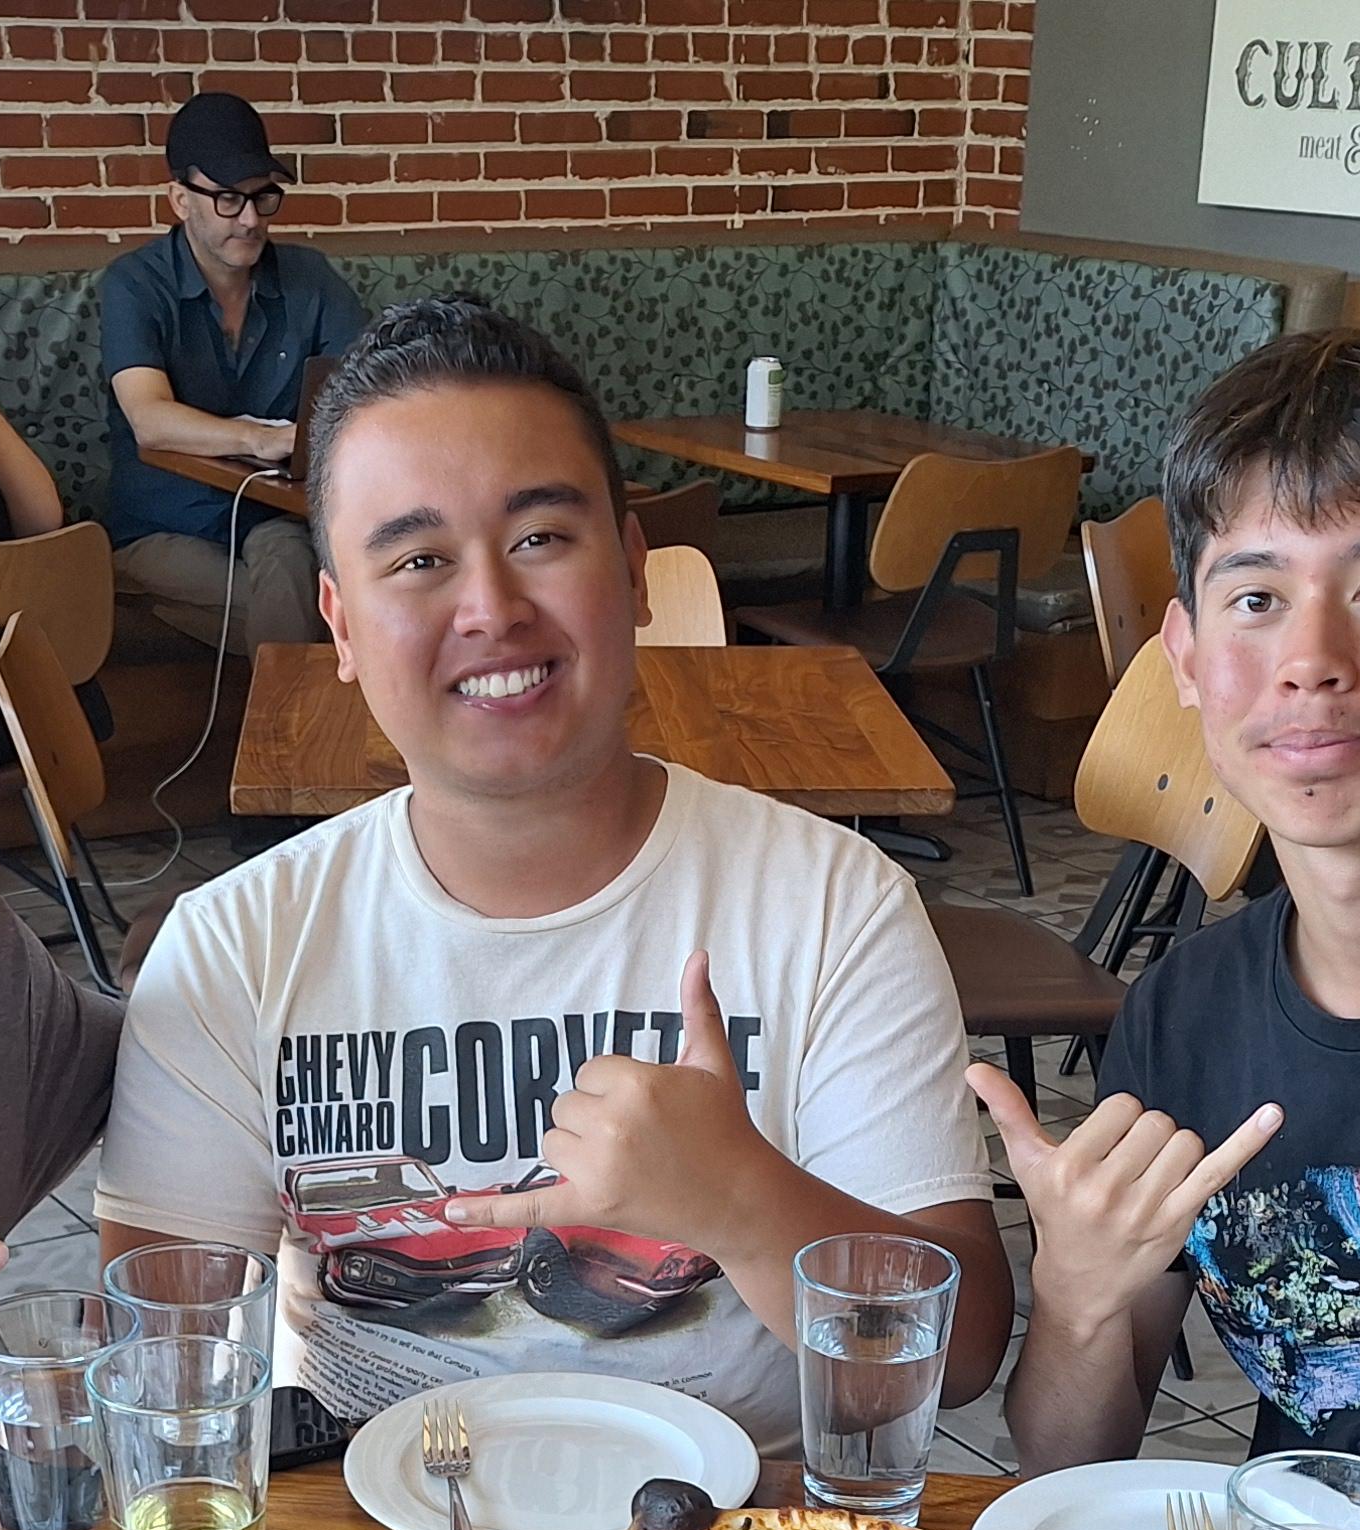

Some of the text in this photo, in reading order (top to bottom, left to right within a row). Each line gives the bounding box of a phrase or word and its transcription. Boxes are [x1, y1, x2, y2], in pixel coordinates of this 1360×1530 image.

[1298, 132, 1341, 162] meat
[275, 1029, 397, 1107] CHEVY
[401, 1010, 762, 1165] CORVE
[275, 1101, 396, 1157] CAMARO
[443, 1355, 472, 1373] Camaro
